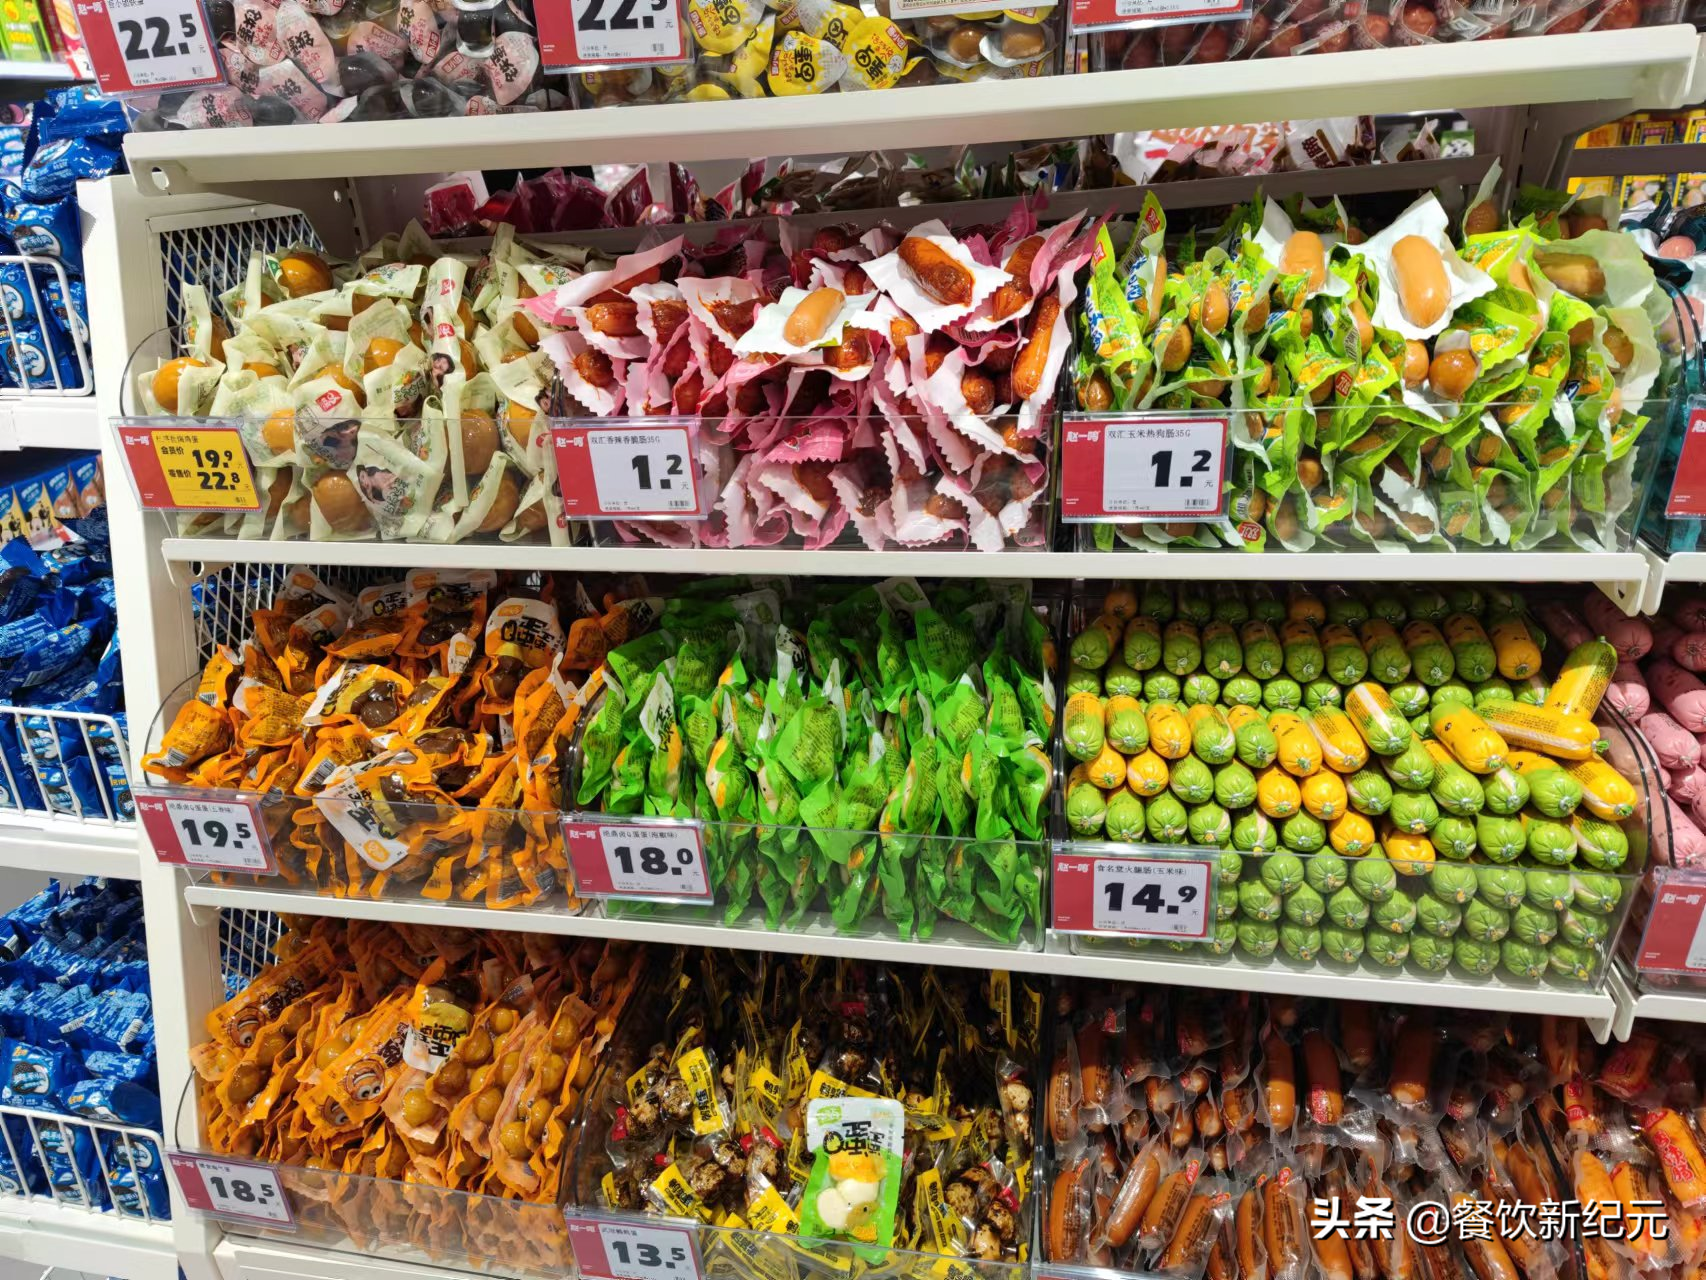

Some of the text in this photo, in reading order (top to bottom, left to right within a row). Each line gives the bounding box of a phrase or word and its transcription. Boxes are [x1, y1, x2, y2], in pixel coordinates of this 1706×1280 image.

[118, 13, 197, 61] 22.5
[125, 436, 150, 445] 赵一鸣
[556, 437, 584, 448] 赵一鸣
[1066, 431, 1101, 443] 赵一鸣
[1108, 429, 1191, 439] 双汇玉米热狗肠35G
[192, 450, 233, 468] 19.9
[1151, 450, 1213, 488] 1.2 元
[198, 472, 240, 490] 22.8
[632, 455, 689, 490] 1.2 元
[181, 819, 251, 849] 19.5
[570, 830, 596, 839] 赵一鸣
[614, 846, 694, 875] 18.0
[1057, 863, 1089, 872] 赵一鸣
[1104, 882, 1198, 914] 14.9
[210, 1177, 274, 1204] 18.5
[612, 1241, 686, 1269] 13.5
